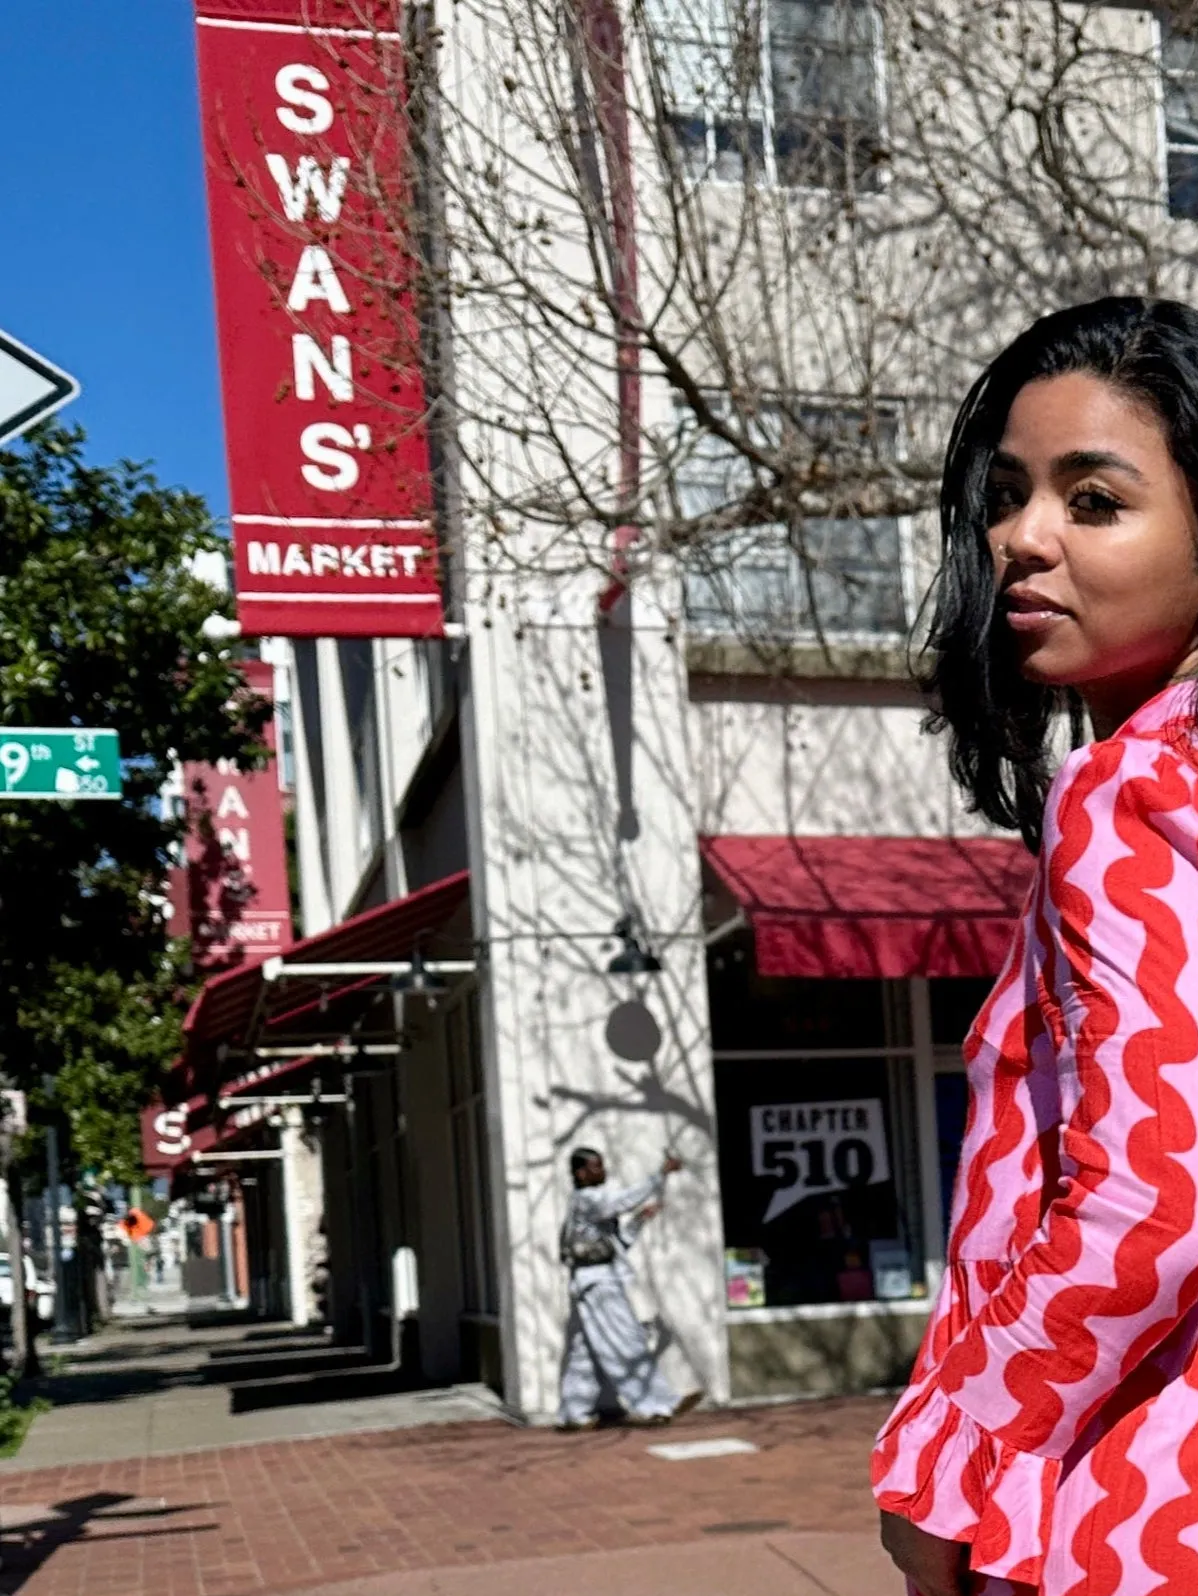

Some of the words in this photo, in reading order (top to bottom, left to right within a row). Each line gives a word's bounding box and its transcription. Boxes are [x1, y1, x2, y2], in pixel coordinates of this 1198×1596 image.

[266, 64, 371, 491] SWANS'
[247, 540, 424, 578] MARKET
[761, 1107, 868, 1132] CHAPTER
[763, 1139, 873, 1189] 510
